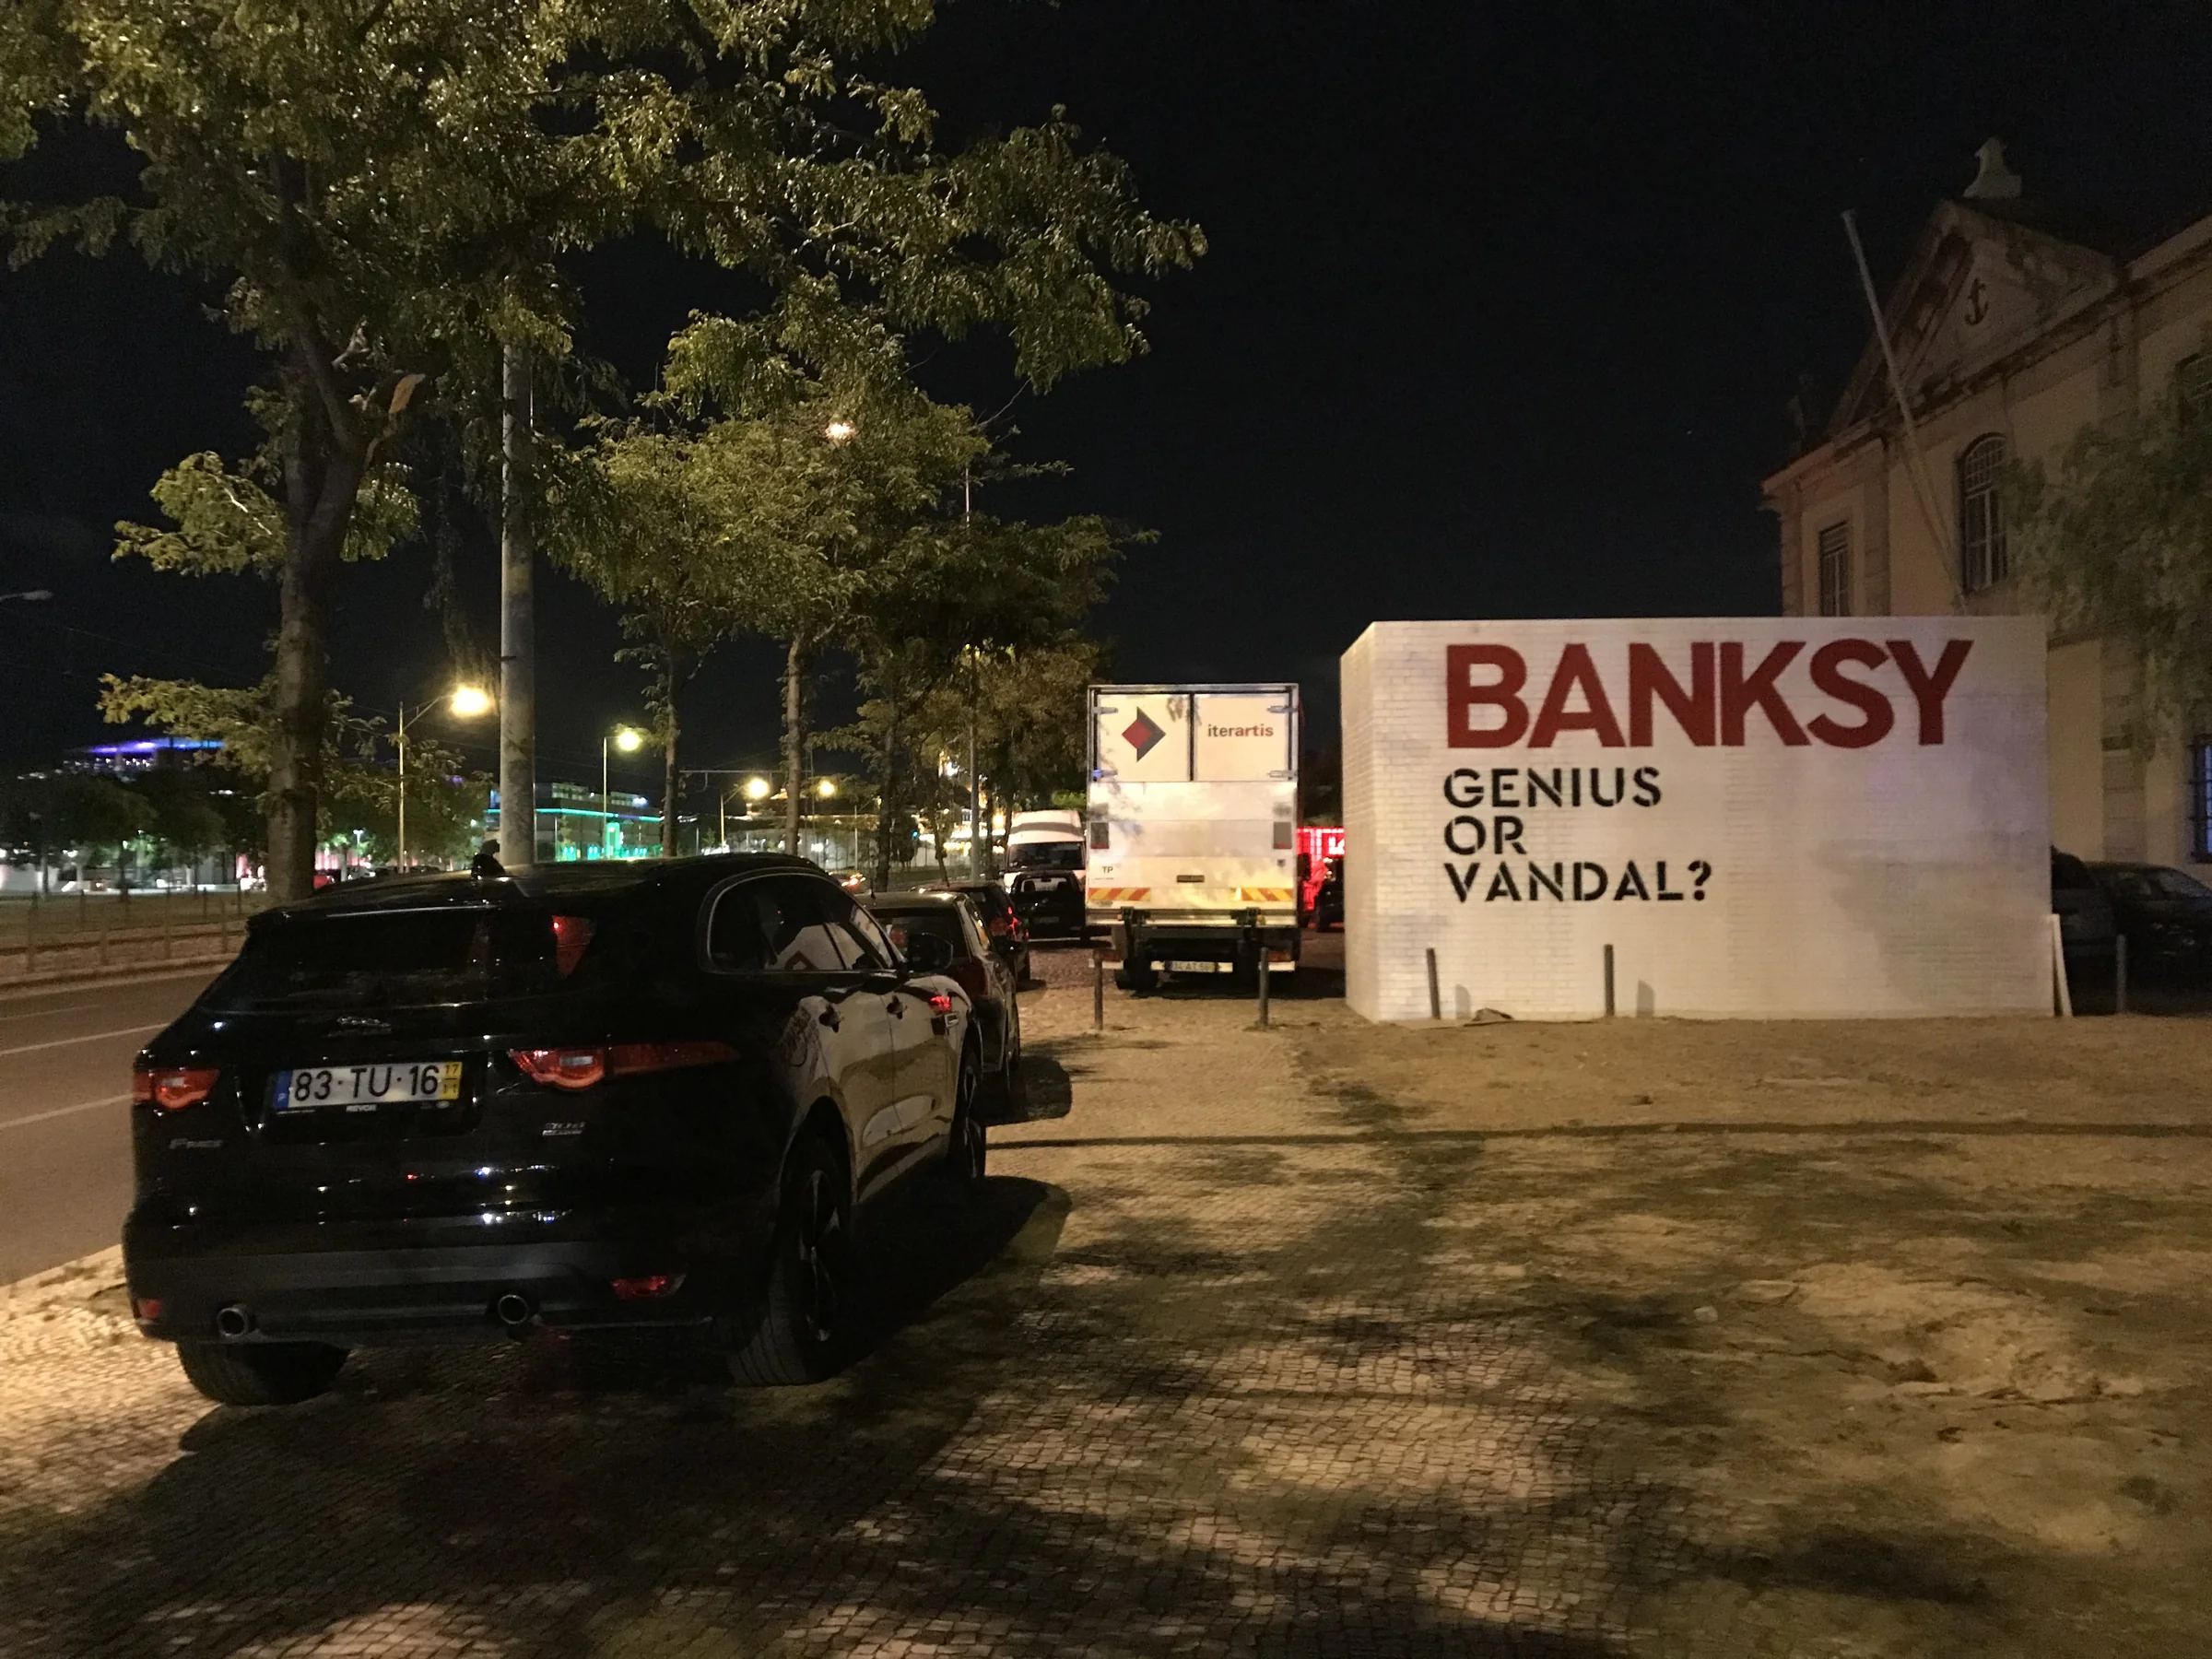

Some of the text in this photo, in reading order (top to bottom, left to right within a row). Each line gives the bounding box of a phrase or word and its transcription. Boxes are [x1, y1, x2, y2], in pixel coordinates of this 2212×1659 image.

[1446, 639, 1974, 748] BANKSY
[1207, 723, 1274, 737] iterartis
[1443, 767, 1662, 808] GENIUS
[1443, 815, 1527, 855] OR
[1443, 860, 1712, 902] VANDAL?
